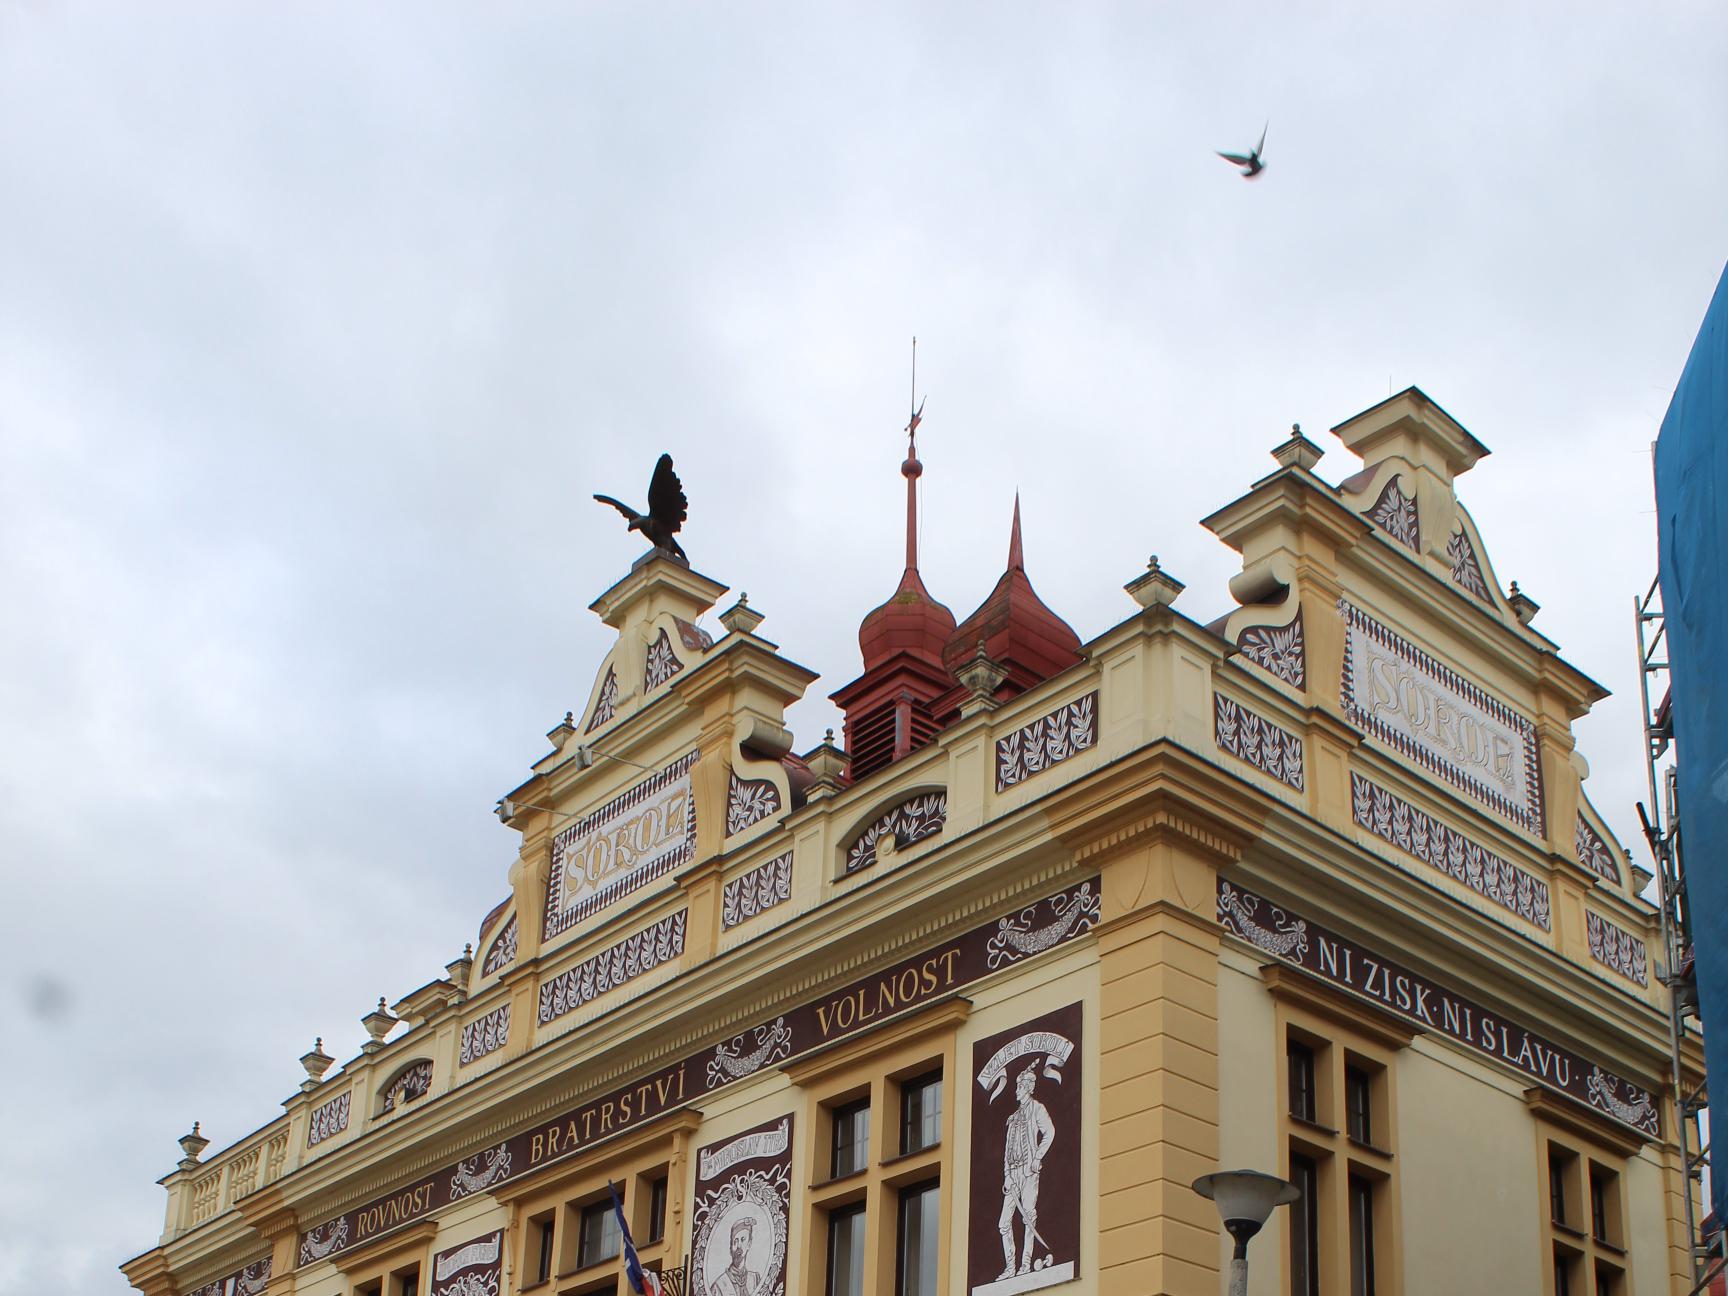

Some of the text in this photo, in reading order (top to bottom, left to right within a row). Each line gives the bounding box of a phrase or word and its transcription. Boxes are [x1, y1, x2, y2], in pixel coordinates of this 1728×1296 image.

[1370, 656, 1515, 781] SOKOL
[566, 794, 685, 897] SOKOL
[816, 949, 961, 1037] VOLNOST
[1318, 936, 1570, 1088] NI ZISK NI SLÁVU
[531, 1062, 685, 1165] BRATRSTVÍ
[356, 1182, 435, 1238] ROVNOST
